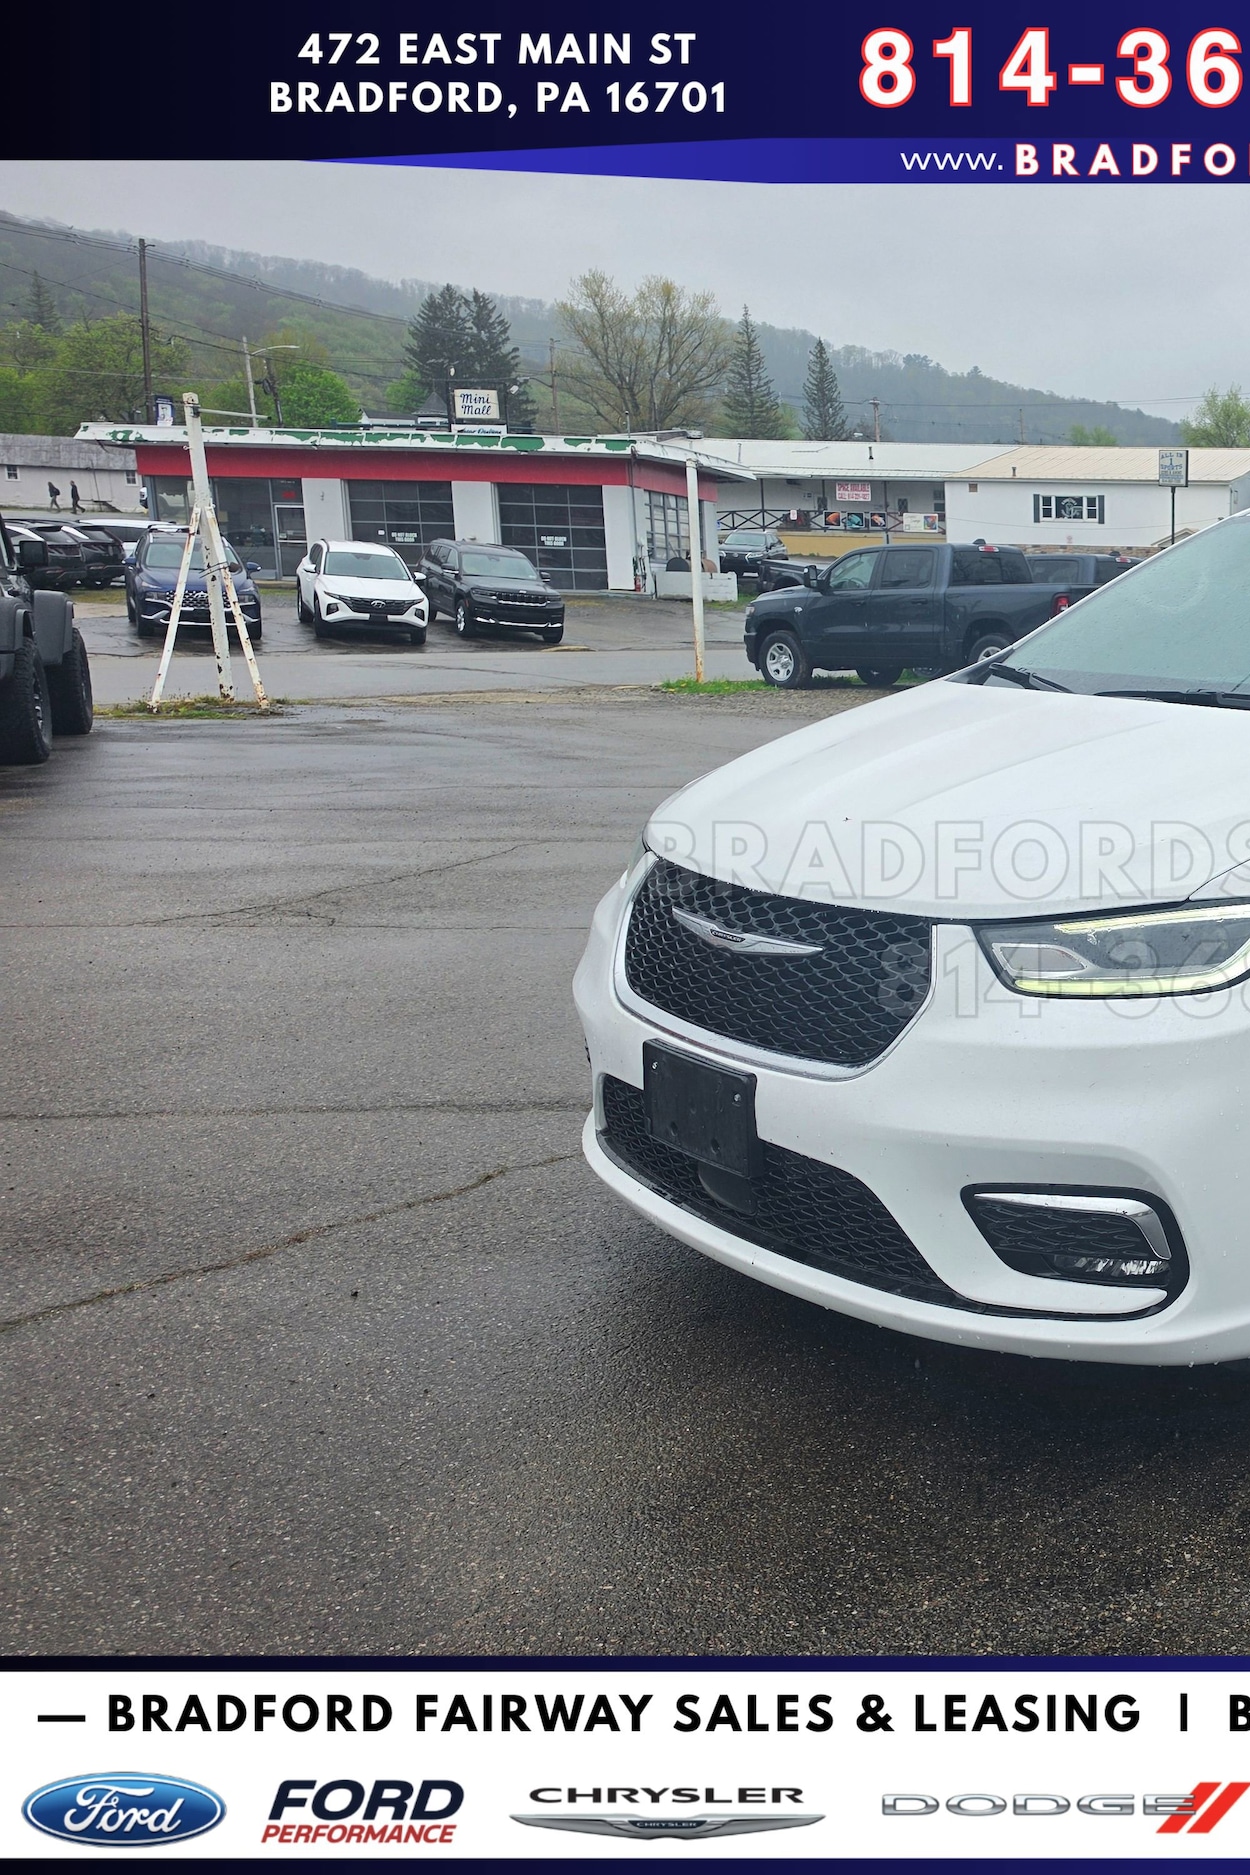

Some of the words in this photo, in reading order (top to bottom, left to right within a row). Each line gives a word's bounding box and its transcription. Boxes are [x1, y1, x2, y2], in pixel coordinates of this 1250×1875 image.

[460, 393, 491, 404] Mini
[461, 405, 491, 416] Mall
[711, 931, 742, 942] CHRYSLER
